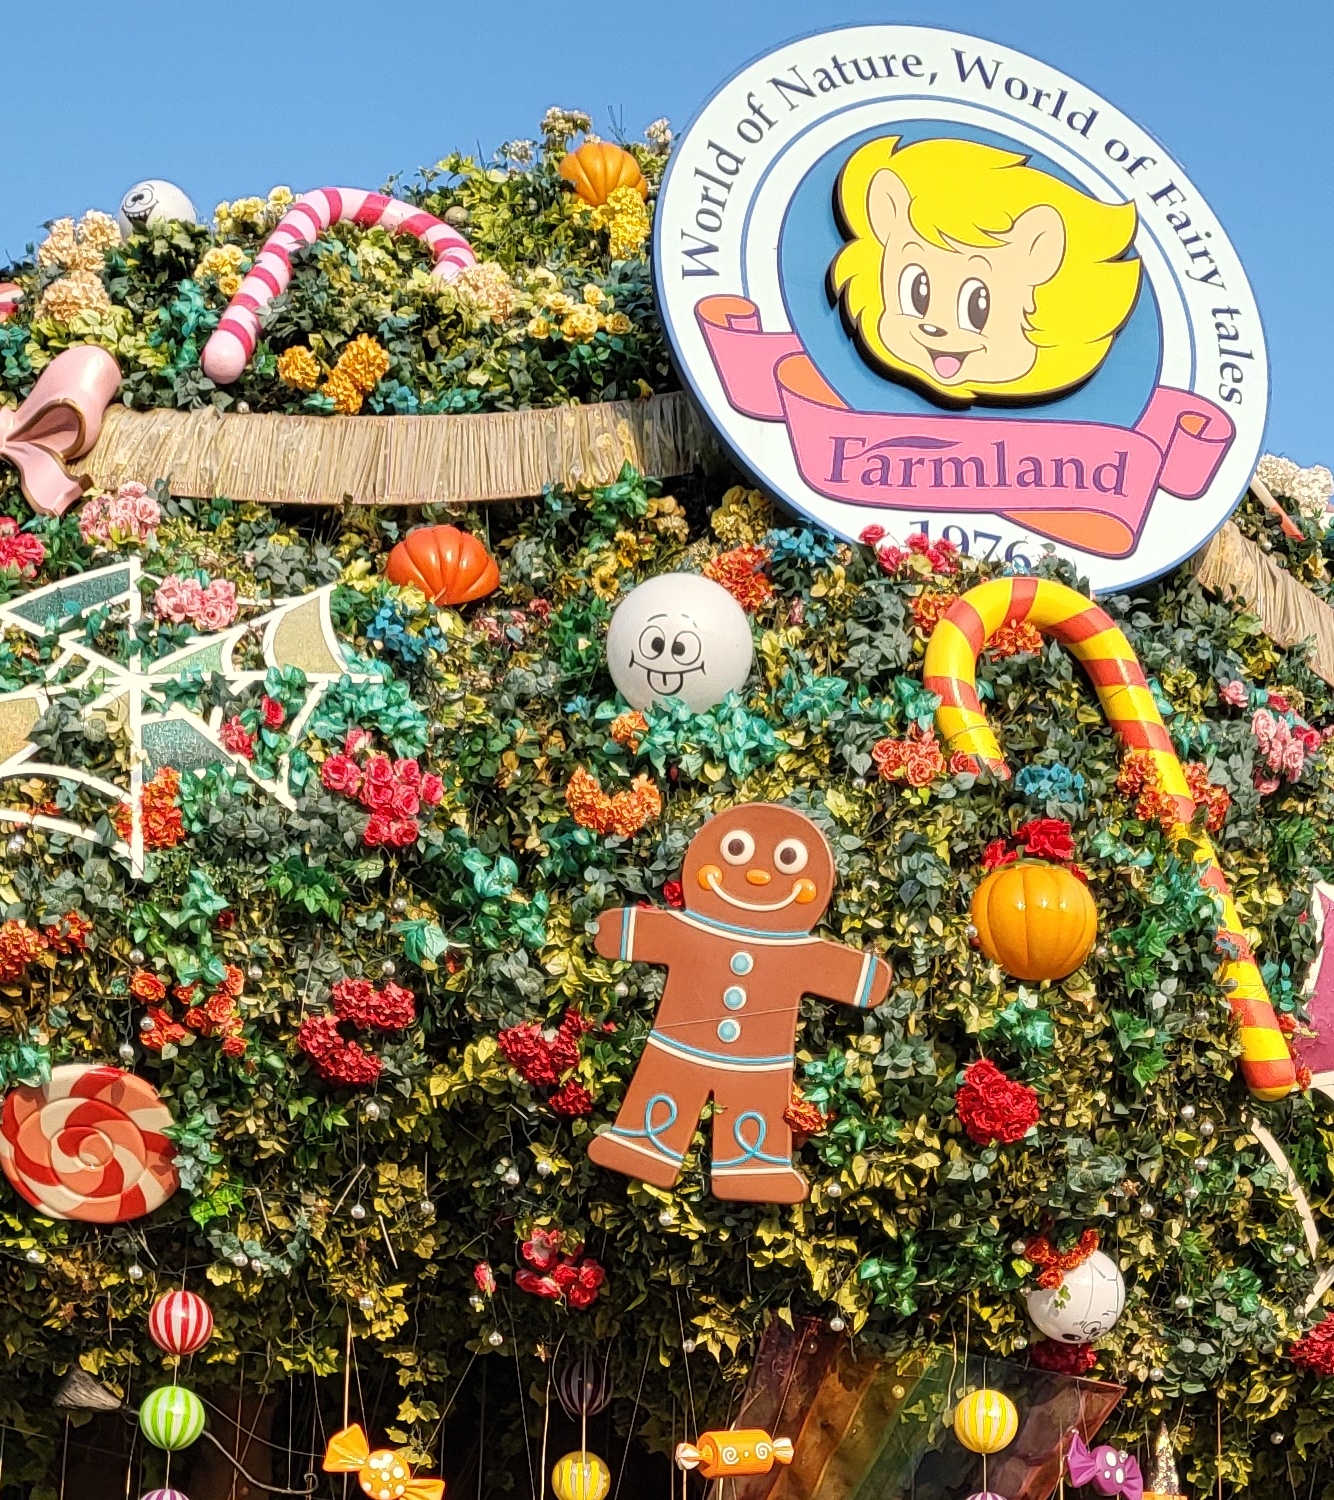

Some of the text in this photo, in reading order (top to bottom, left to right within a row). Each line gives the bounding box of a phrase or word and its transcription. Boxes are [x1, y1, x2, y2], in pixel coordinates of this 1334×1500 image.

[680, 48, 1255, 405] World of Nature, World of Fairy tales
[824, 434, 1131, 498] Farmland
